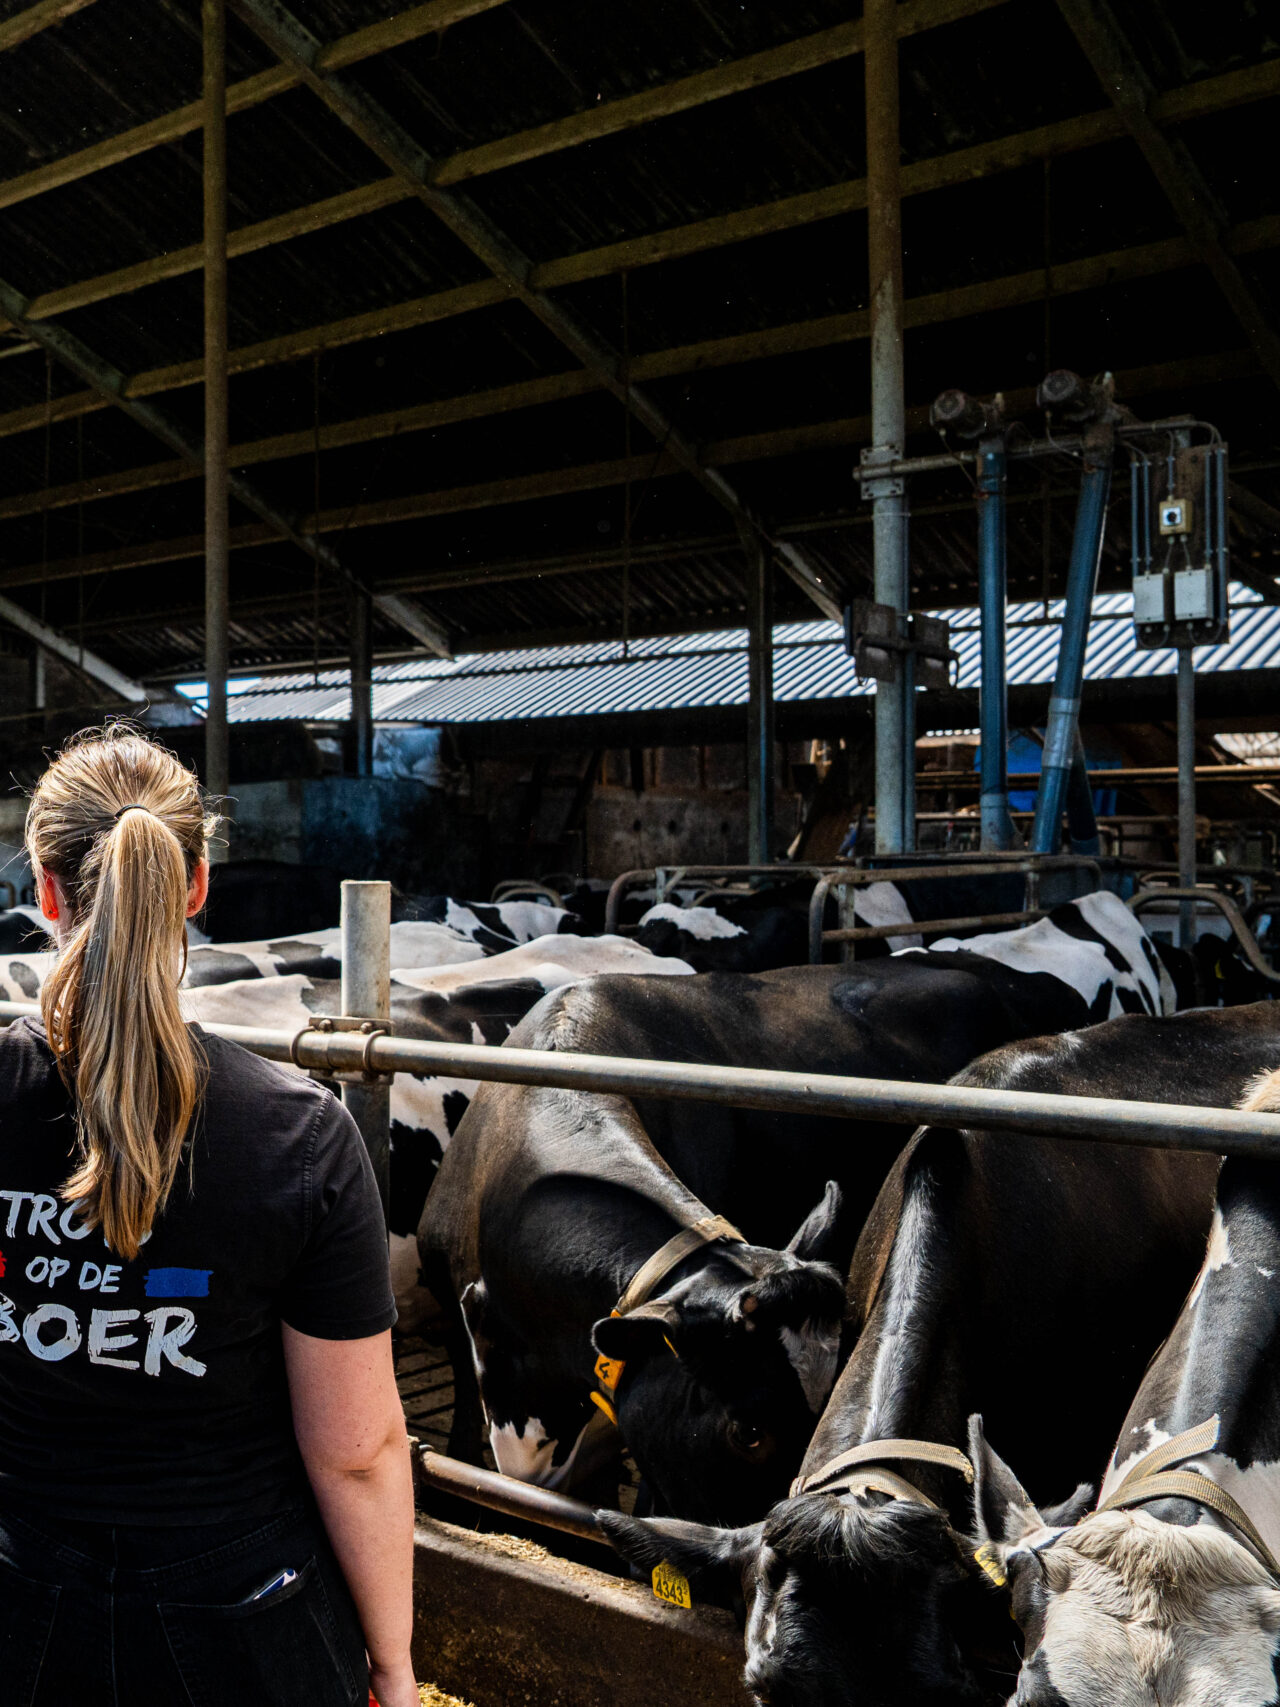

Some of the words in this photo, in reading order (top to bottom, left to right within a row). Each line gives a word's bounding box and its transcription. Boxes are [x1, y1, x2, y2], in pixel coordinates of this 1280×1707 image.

[0, 1190, 153, 1248] TRO
[25, 1256, 70, 1288] OP
[78, 1260, 123, 1293] DE
[656, 1578, 683, 1604] 4343
